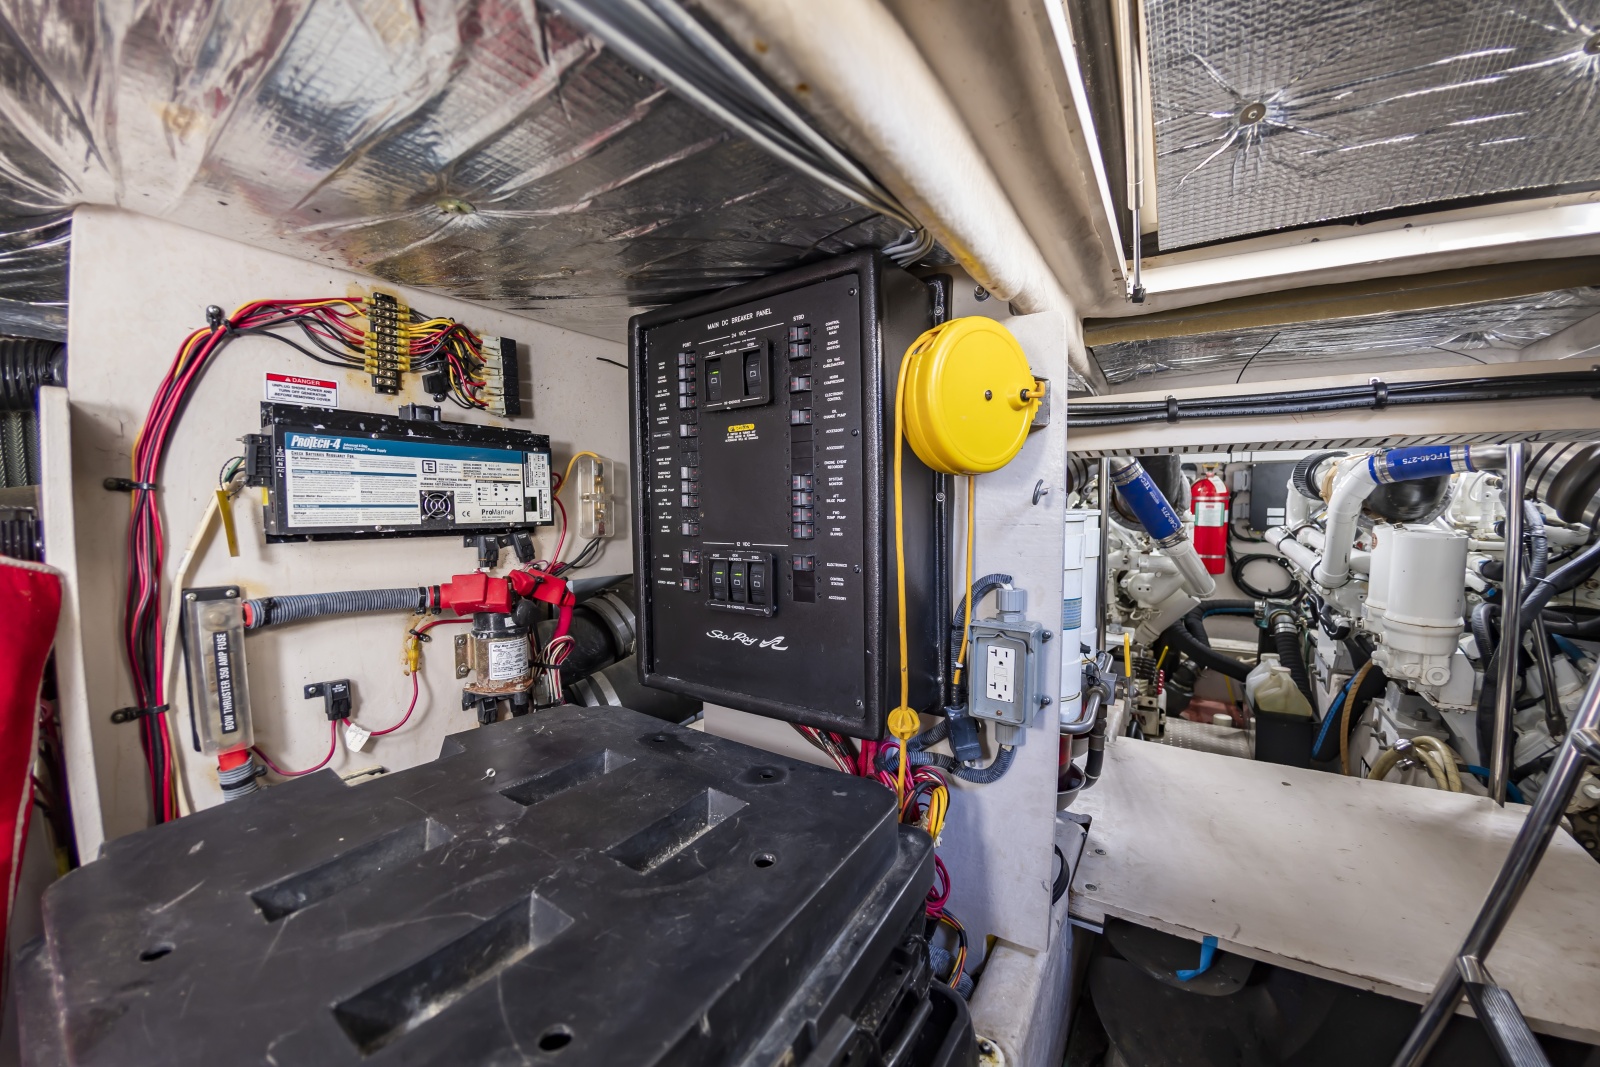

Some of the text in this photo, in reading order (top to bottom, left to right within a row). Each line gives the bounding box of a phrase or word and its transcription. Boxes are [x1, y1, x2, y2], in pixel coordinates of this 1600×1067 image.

[707, 322, 719, 330] MAIN
[731, 312, 753, 324] BREAKER
[756, 308, 772, 317] PANEL
[292, 377, 320, 386] DANGER
[706, 630, 758, 646] Sea Ray
[216, 633, 235, 731] BOW THRUSTER 350 AMP FUSE
